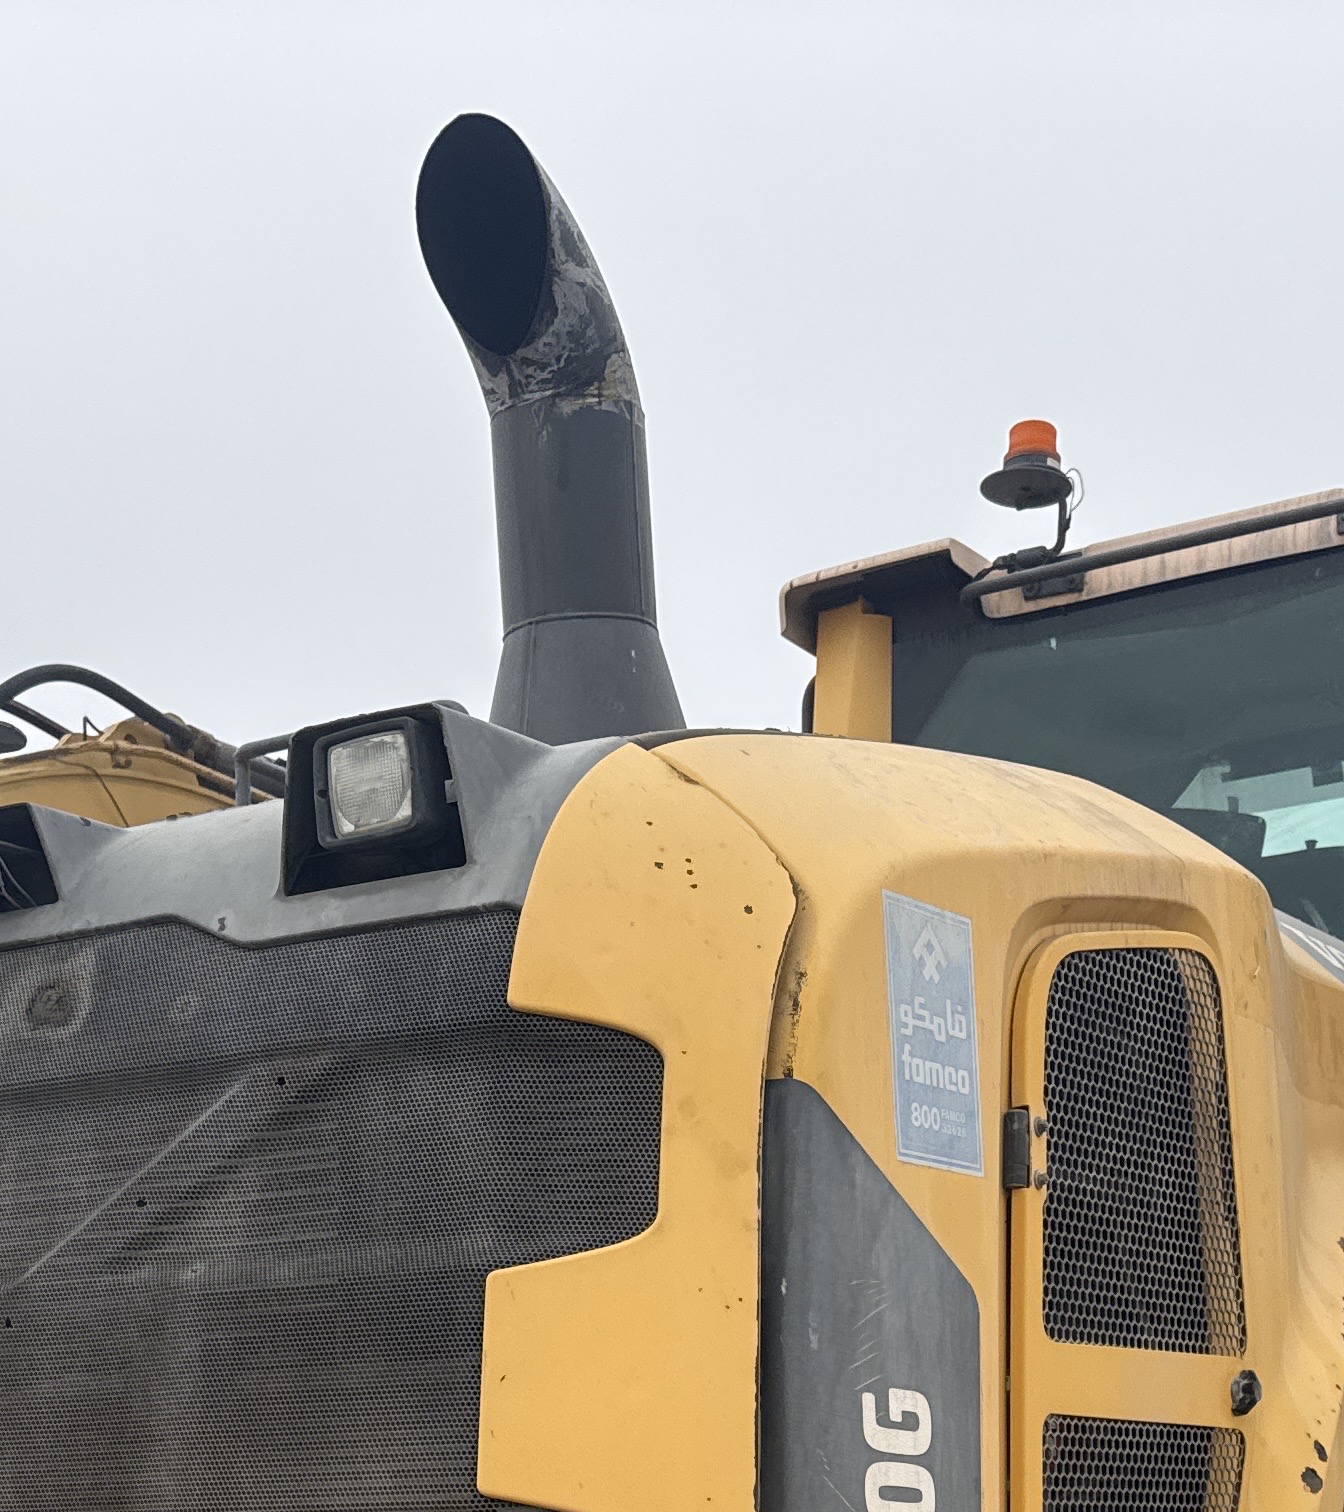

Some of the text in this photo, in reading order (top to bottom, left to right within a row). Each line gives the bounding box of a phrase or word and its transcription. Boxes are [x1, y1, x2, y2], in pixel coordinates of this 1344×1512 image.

[900, 995, 967, 1043] فامكو
[902, 1042, 970, 1095] famco
[911, 1102, 941, 1132] 800
